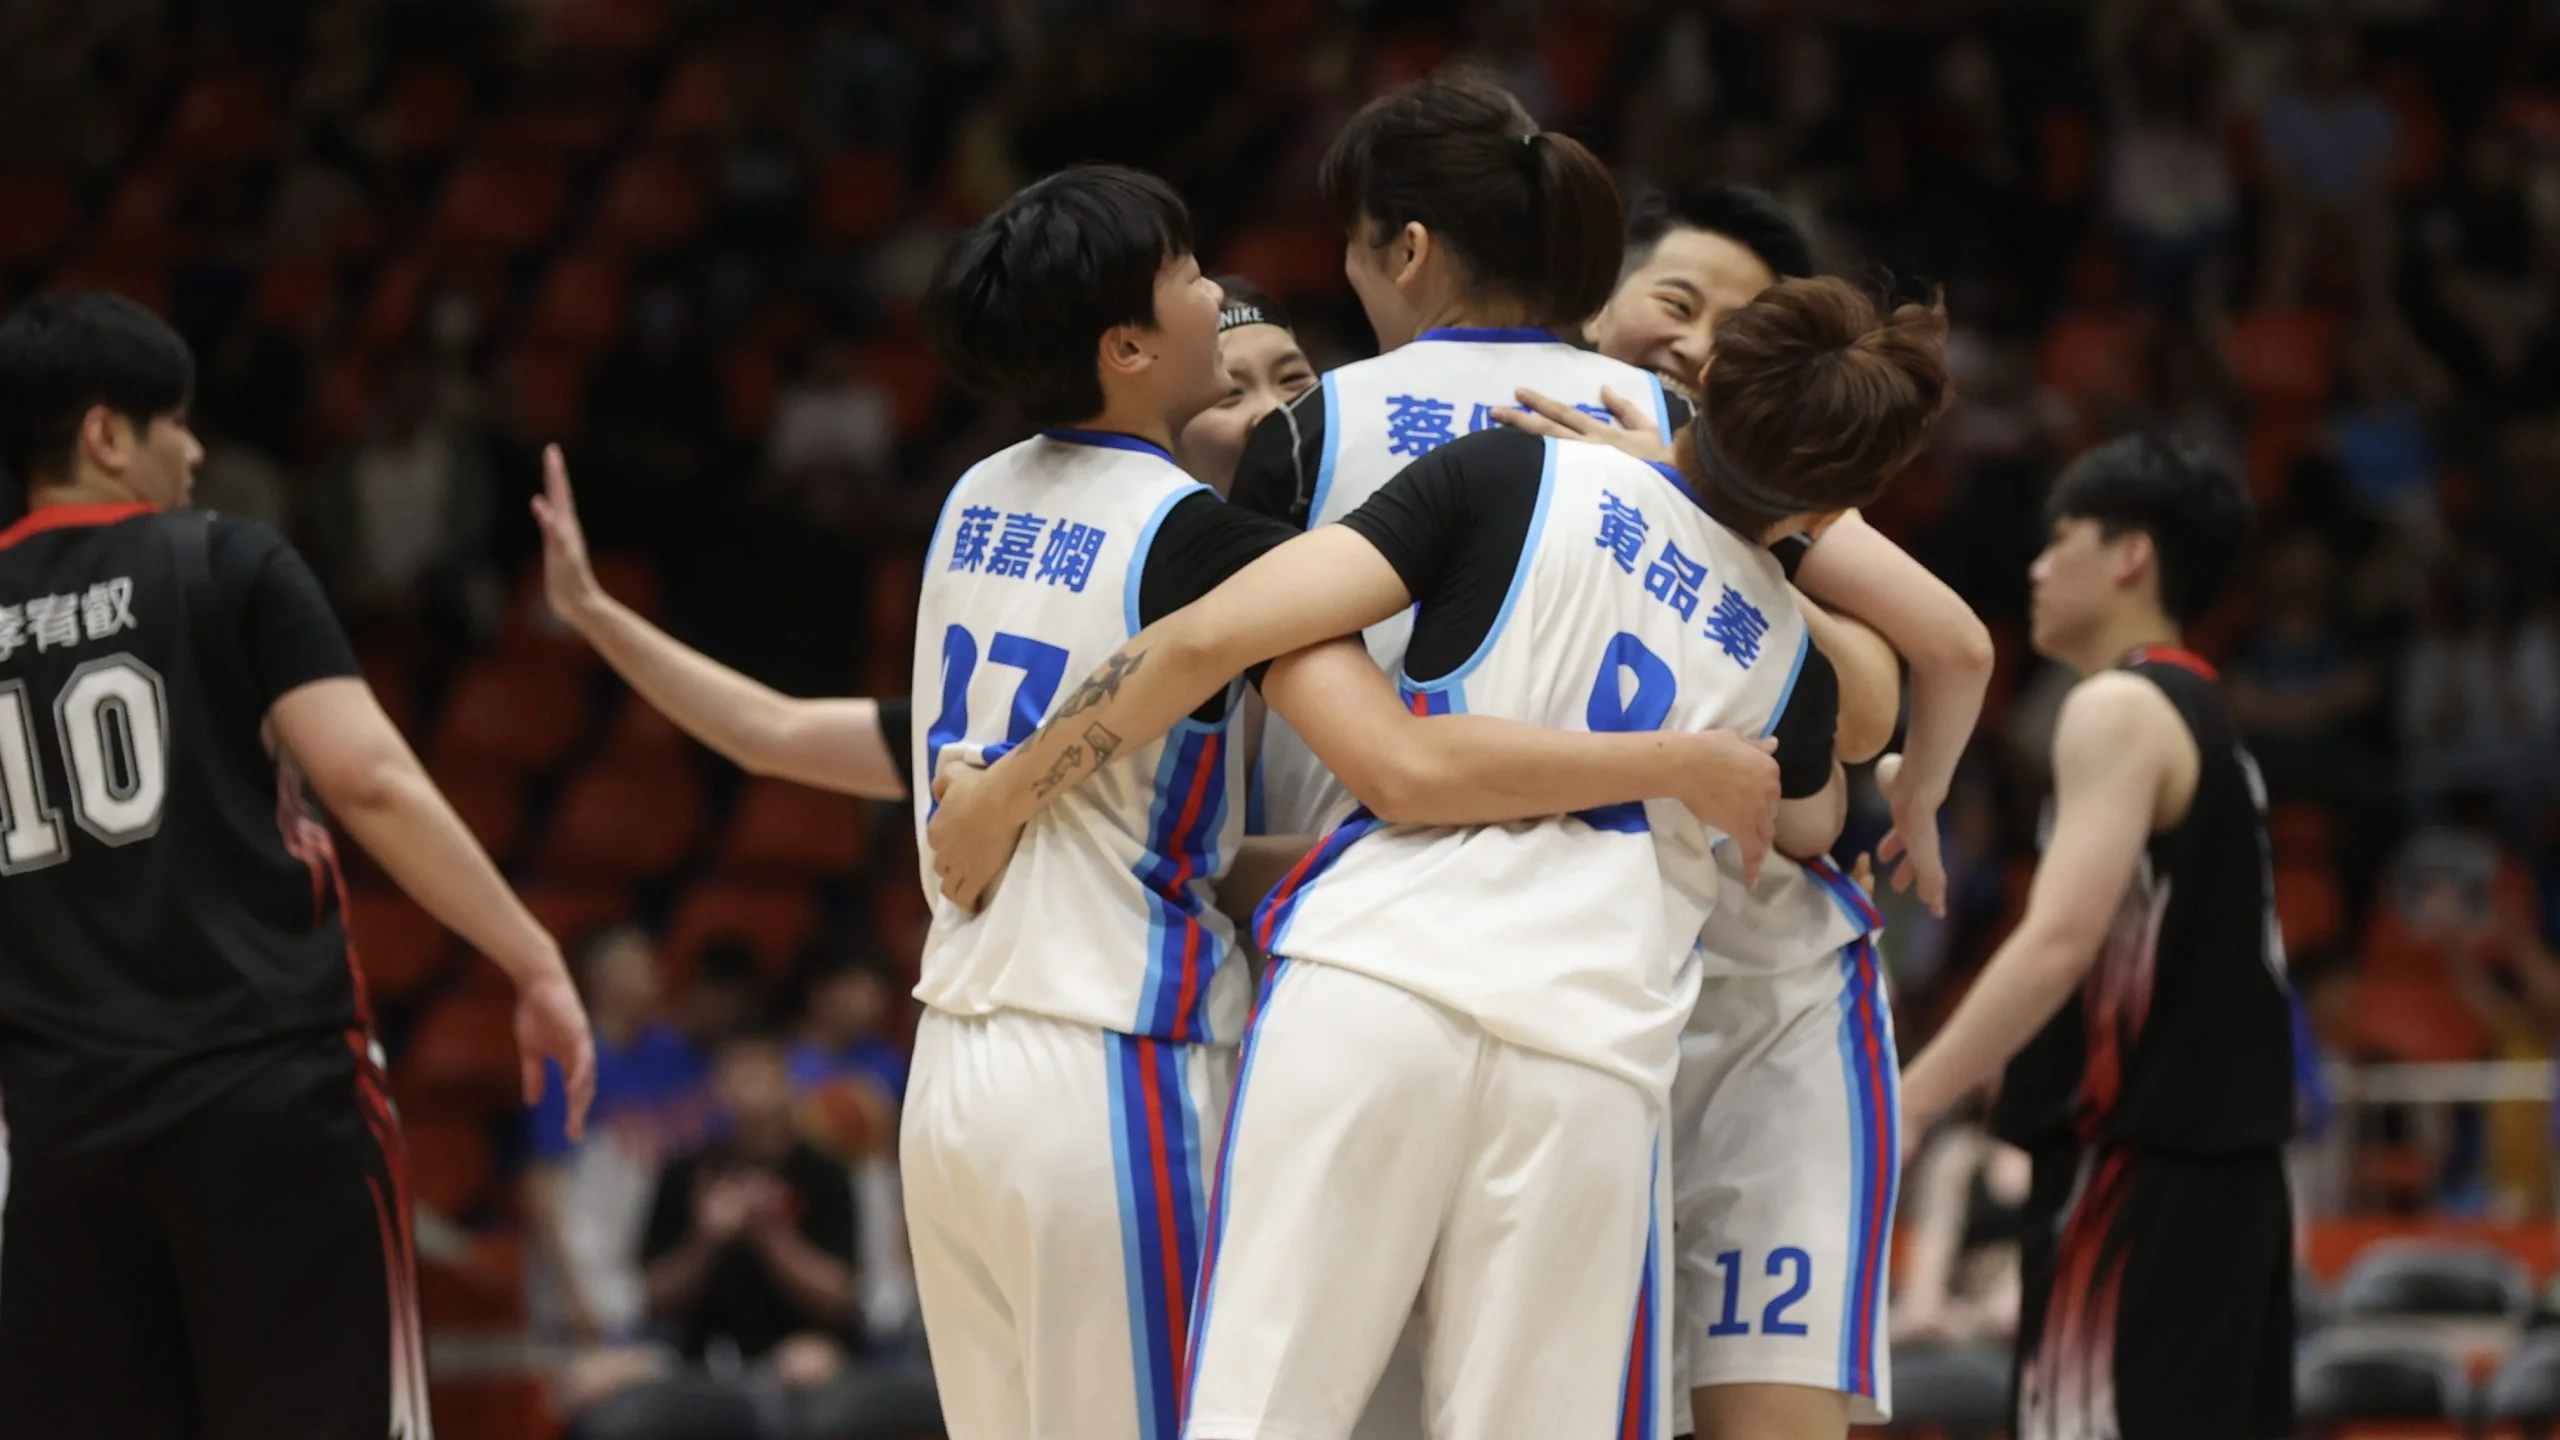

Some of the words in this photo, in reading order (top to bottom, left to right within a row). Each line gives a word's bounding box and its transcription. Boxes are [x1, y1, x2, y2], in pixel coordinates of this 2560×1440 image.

[1218, 306, 1264, 329] NIKE
[1594, 489, 1770, 670] 黃品蓁
[0, 652, 170, 876] 10
[1707, 1246, 1811, 1337] 12
